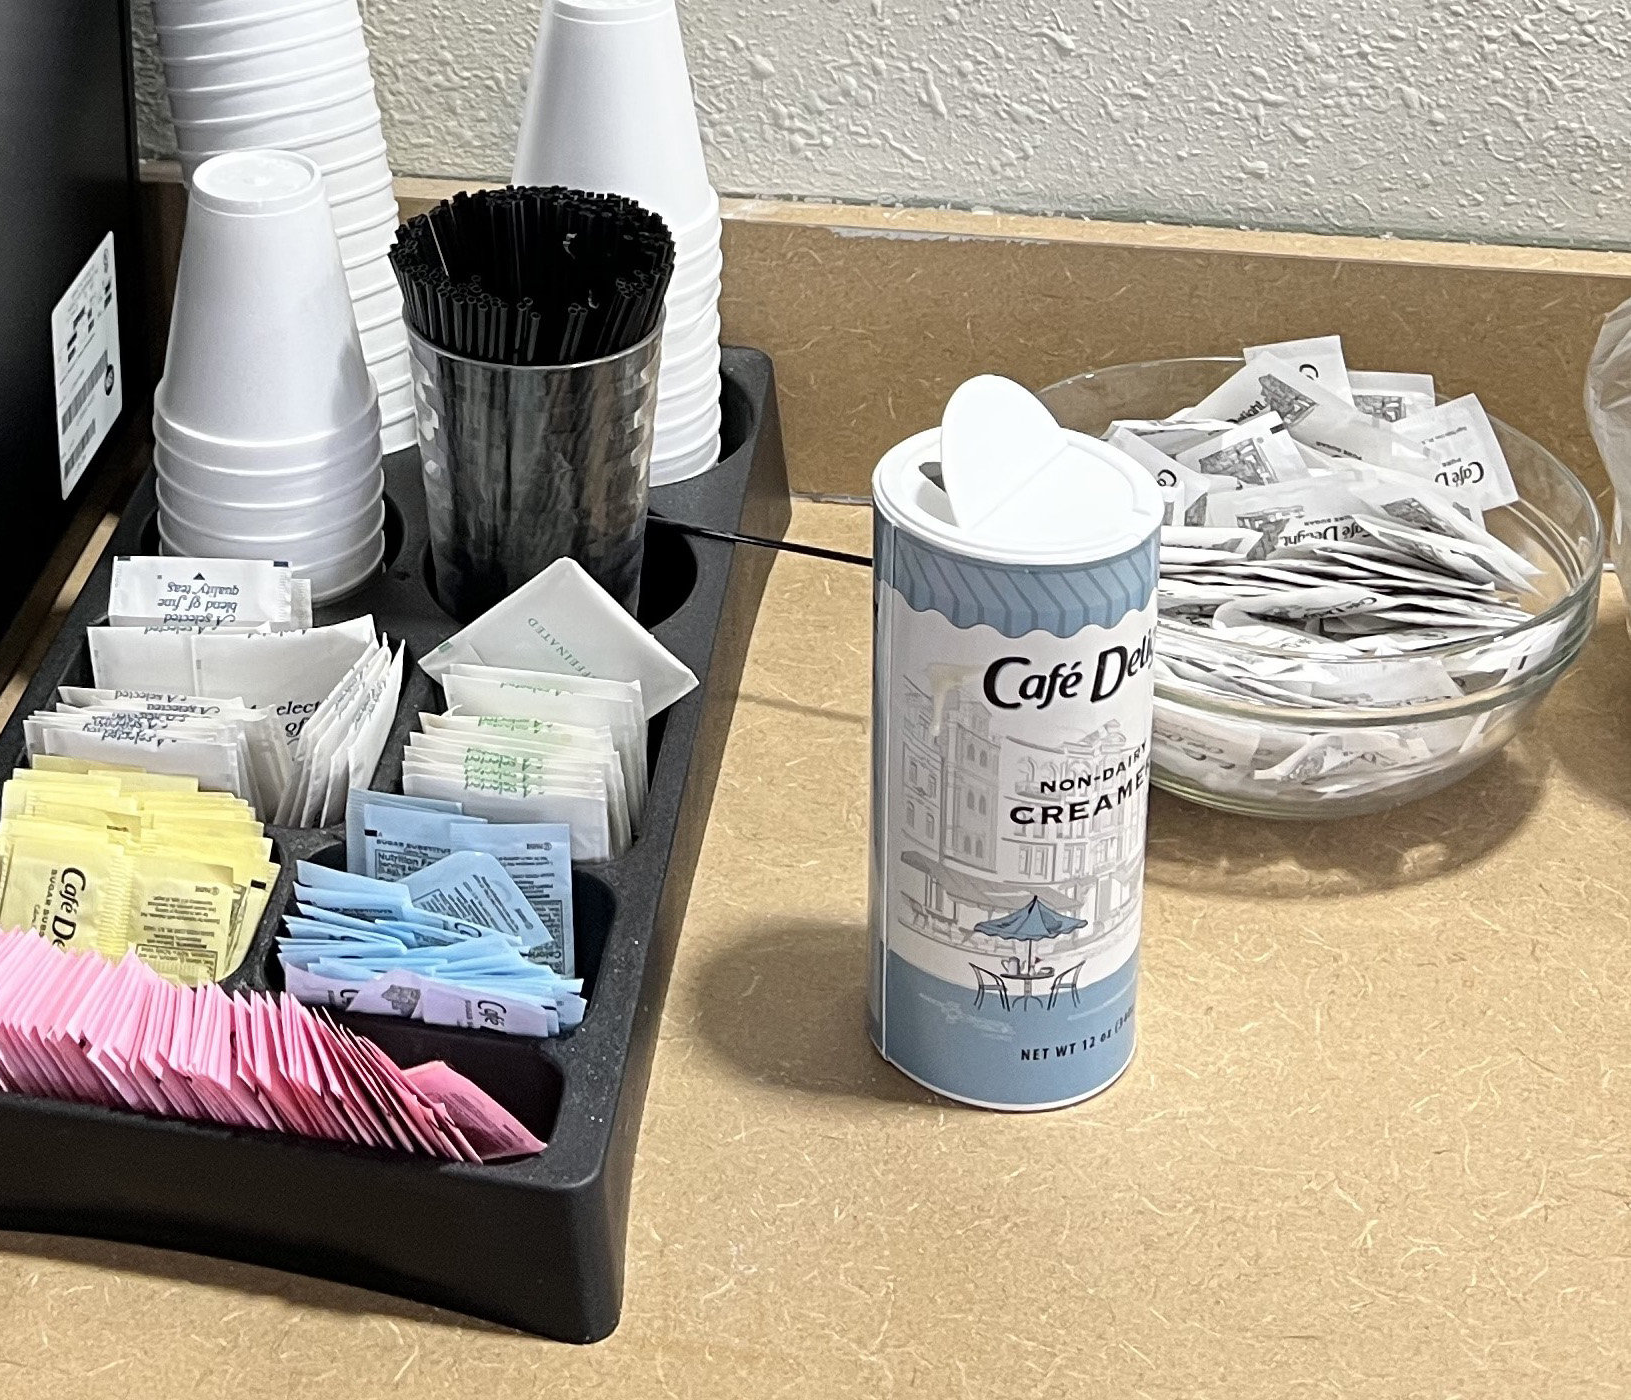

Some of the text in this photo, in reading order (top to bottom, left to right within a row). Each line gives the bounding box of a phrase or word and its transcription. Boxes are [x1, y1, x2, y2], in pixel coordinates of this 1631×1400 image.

[166, 581, 240, 598] quality teas
[156, 595, 238, 613] blend of fine
[164, 613, 236, 630] A selected
[528, 617, 596, 678] FFEINATED
[983, 656, 1083, 710] Café
[1040, 738, 1147, 794] NON-DAIRY
[376, 838, 404, 847] SUGAR
[378, 852, 419, 868] Nutrition
[45, 869, 58, 906] SUGAR
[58, 867, 87, 915] Café
[477, 1000, 507, 1027] Café
[1020, 1048, 1050, 1061] NET
[1055, 1042, 1076, 1057] WT
[1082, 1036, 1096, 1051] 12
